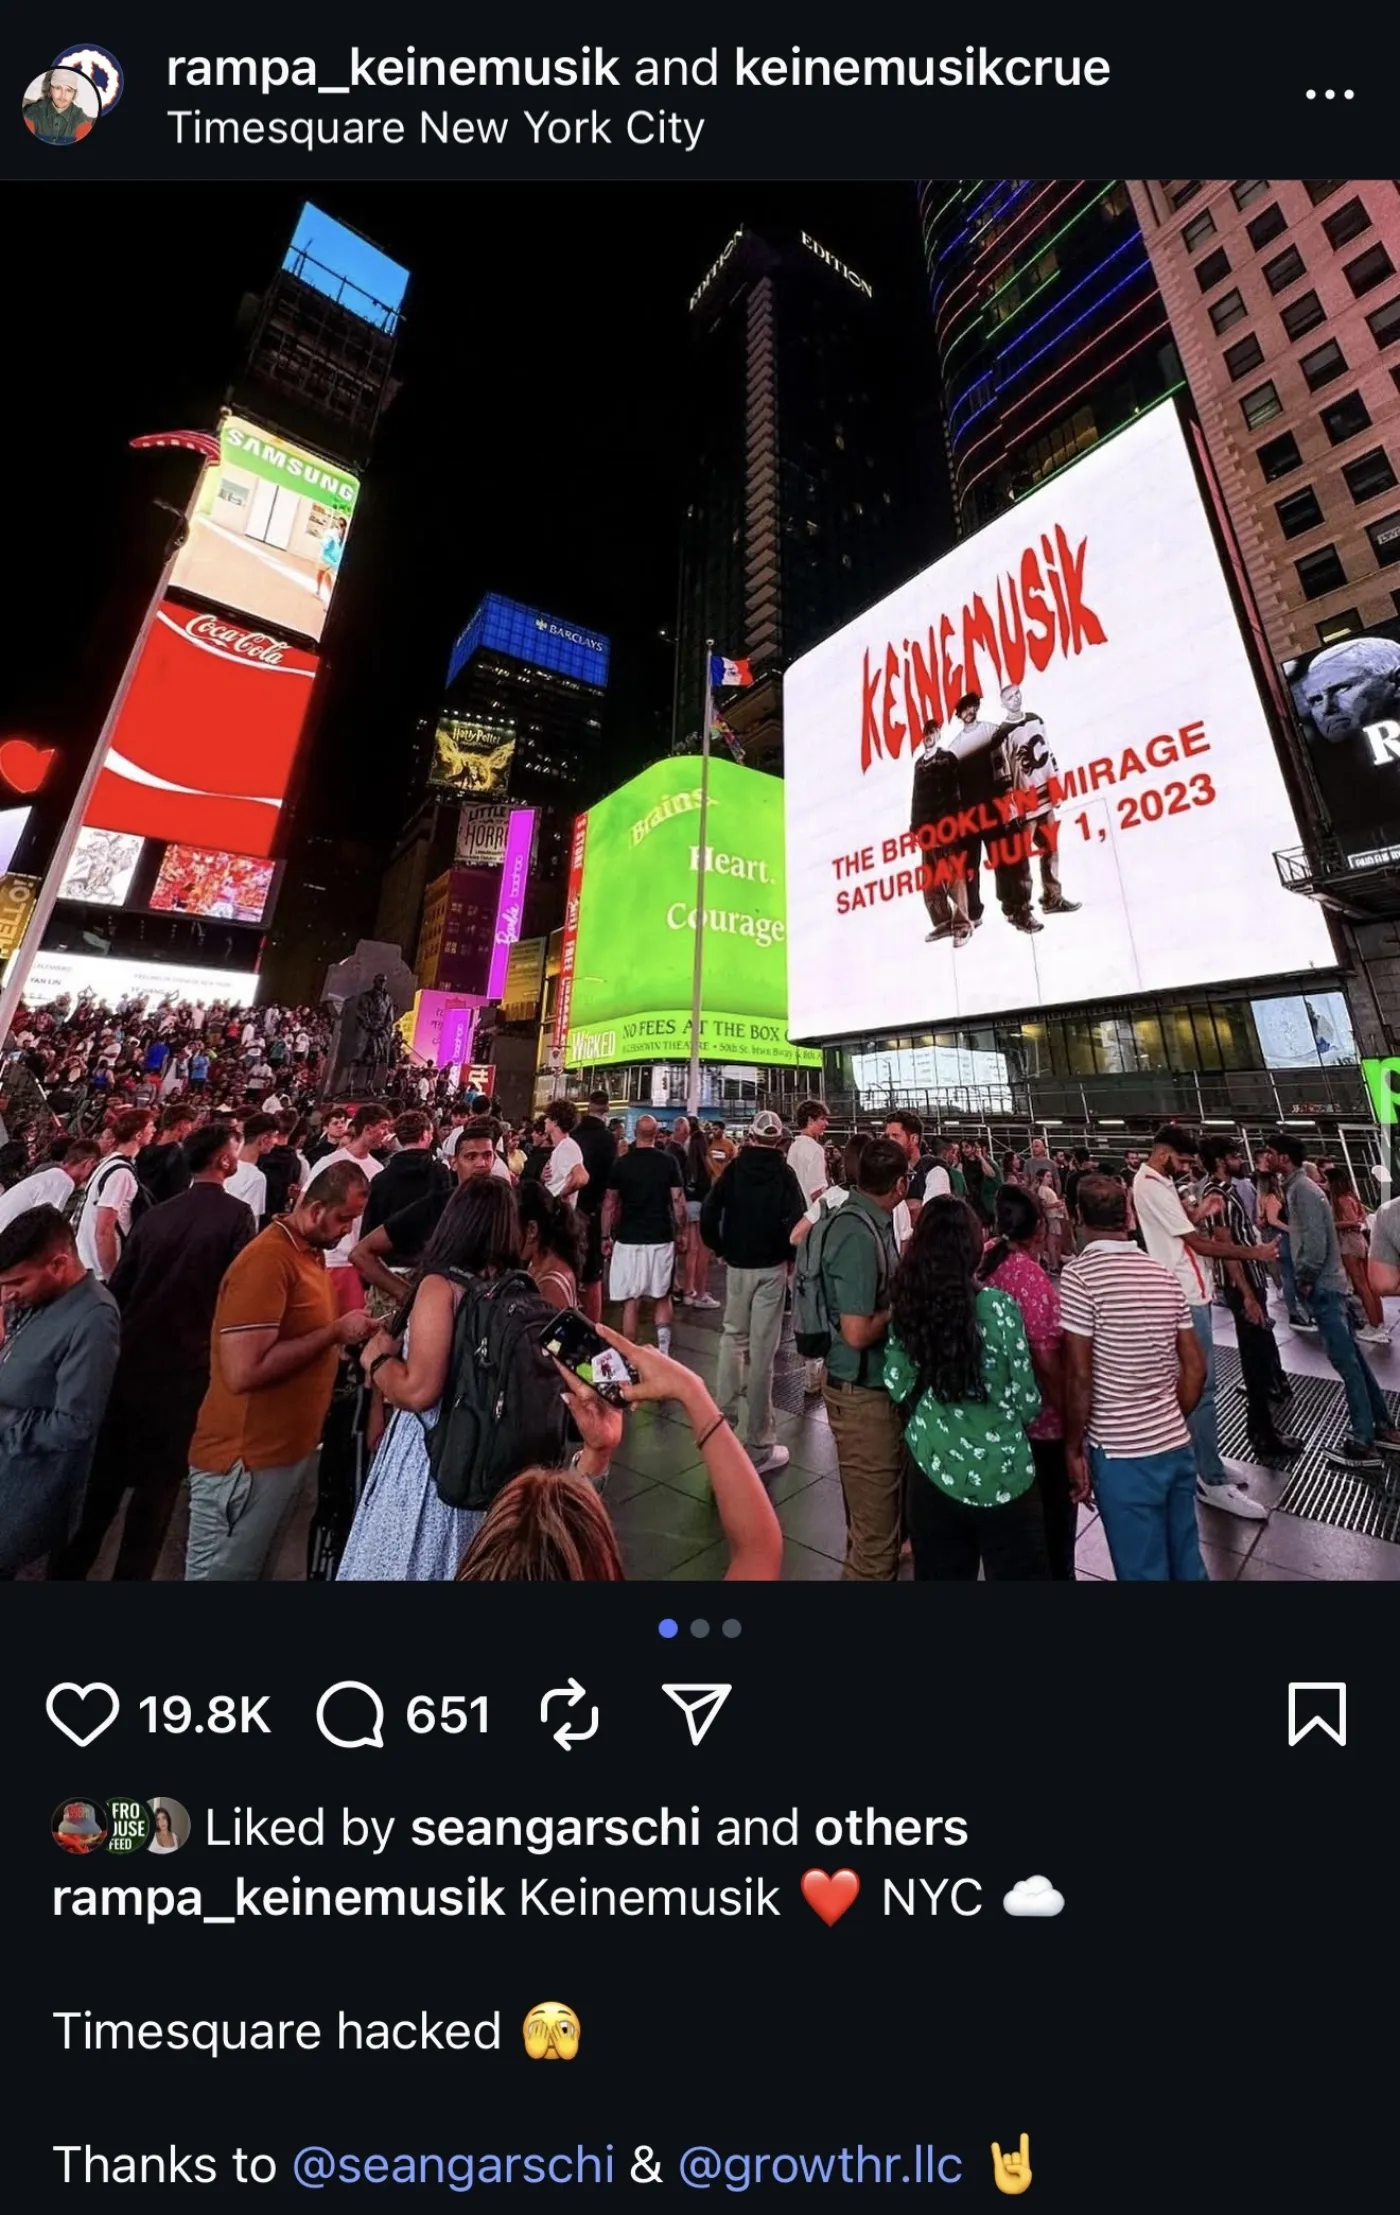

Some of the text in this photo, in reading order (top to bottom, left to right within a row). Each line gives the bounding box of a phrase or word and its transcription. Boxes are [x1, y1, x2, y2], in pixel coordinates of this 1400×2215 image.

[801, 230, 872, 298] EDITION
[227, 427, 355, 500] SAMSUNG
[185, 613, 291, 665] Coca-Cola
[550, 625, 603, 652] BARCLAYS
[453, 727, 501, 744] Harry Potter
[468, 806, 506, 821] LITTLE
[831, 720, 1212, 881] THE BROOKLYN MIRAGE
[465, 823, 508, 854] HORR
[835, 773, 1217, 915] SATURDAY, JULY 1, 2023
[623, 1023, 637, 1040] NO
[639, 1018, 676, 1037] FEES
[713, 1020, 745, 1039] THE
[750, 1024, 780, 1042] BOX
